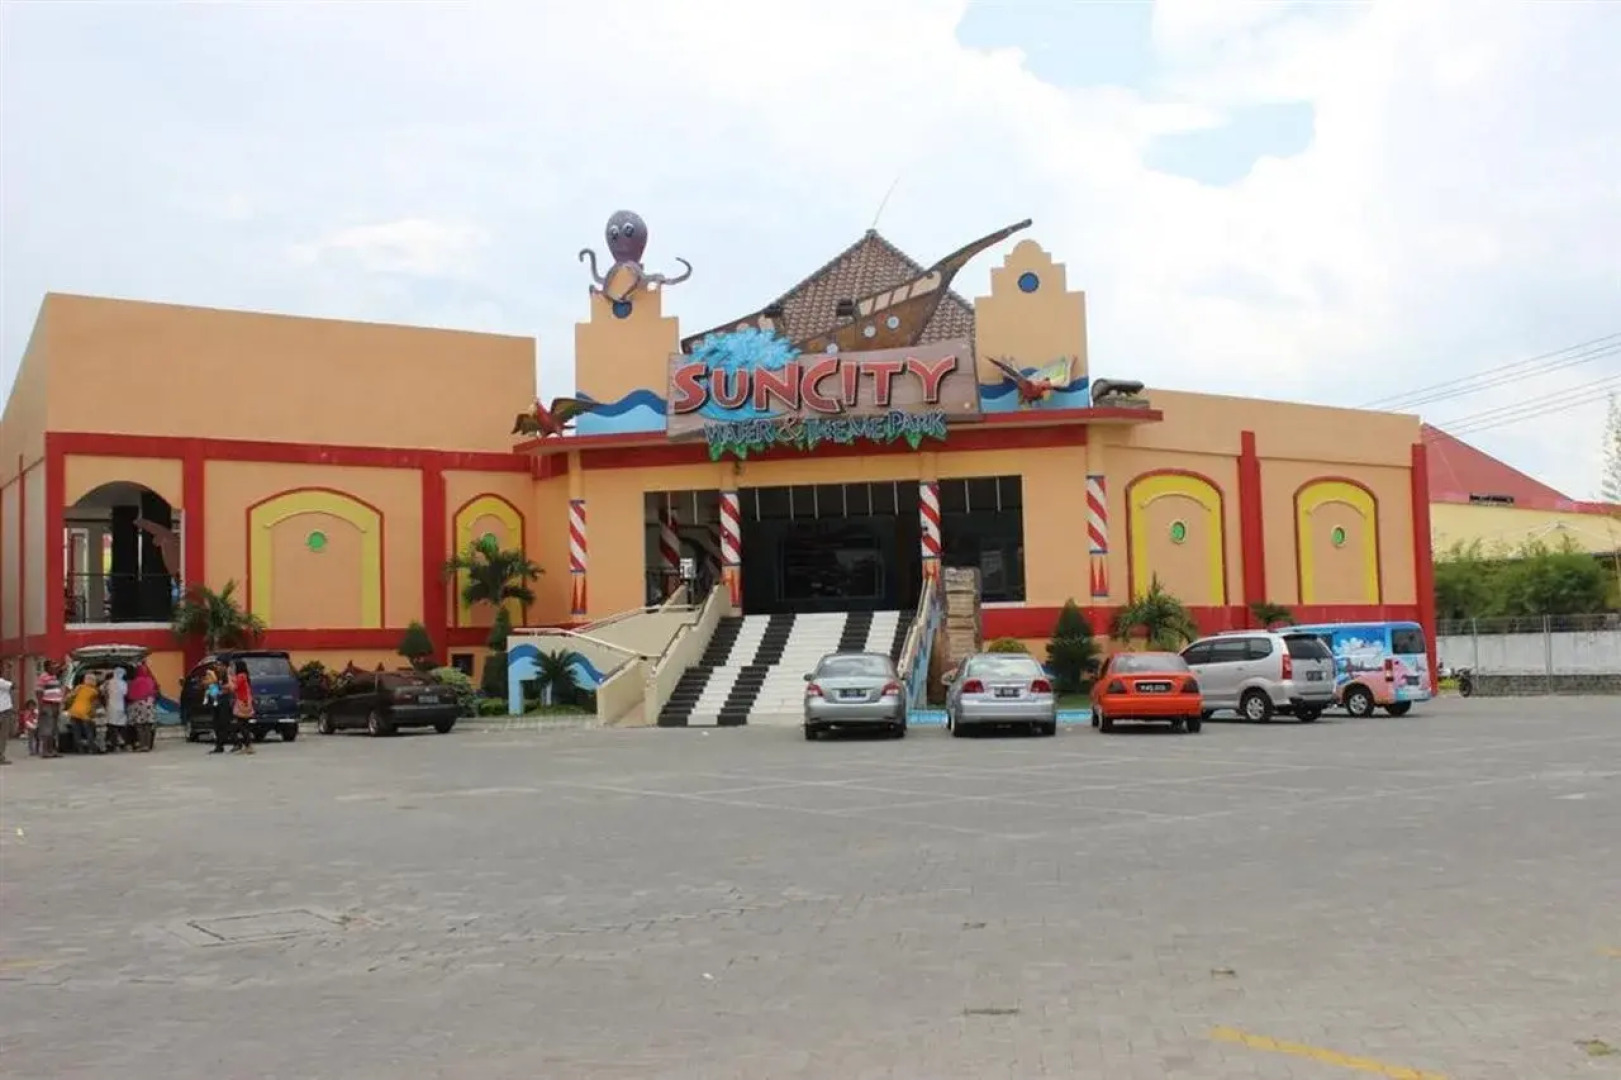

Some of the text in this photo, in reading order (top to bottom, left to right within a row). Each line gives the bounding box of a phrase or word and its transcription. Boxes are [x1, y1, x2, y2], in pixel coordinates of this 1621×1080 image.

[704, 418, 774, 444] WATER
[777, 415, 806, 442] &
[887, 410, 947, 439] PARK
